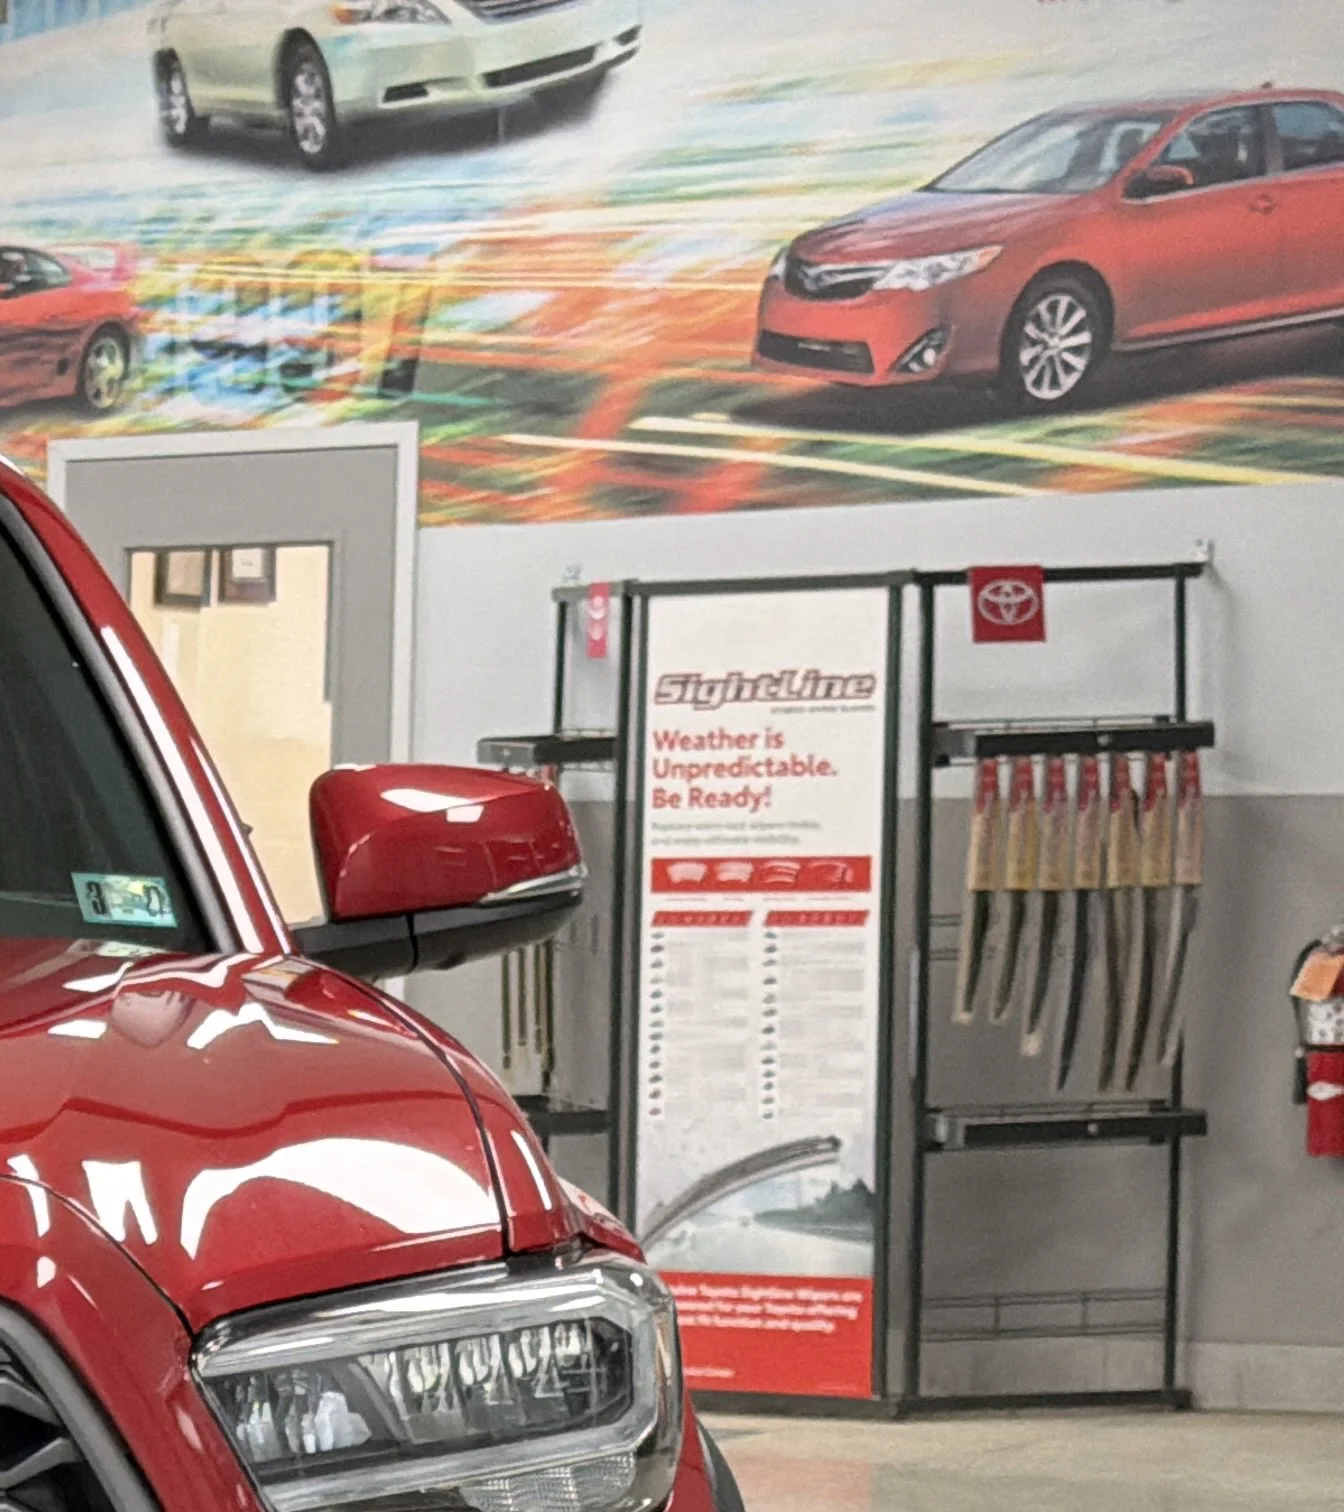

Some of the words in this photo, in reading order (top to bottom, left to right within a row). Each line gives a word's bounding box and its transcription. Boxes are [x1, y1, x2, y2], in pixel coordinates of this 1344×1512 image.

[652, 728, 760, 751] Weather
[764, 726, 786, 750] is
[651, 754, 838, 784] Unpredictable.
[651, 786, 682, 810] Be
[687, 784, 773, 814] Ready!
